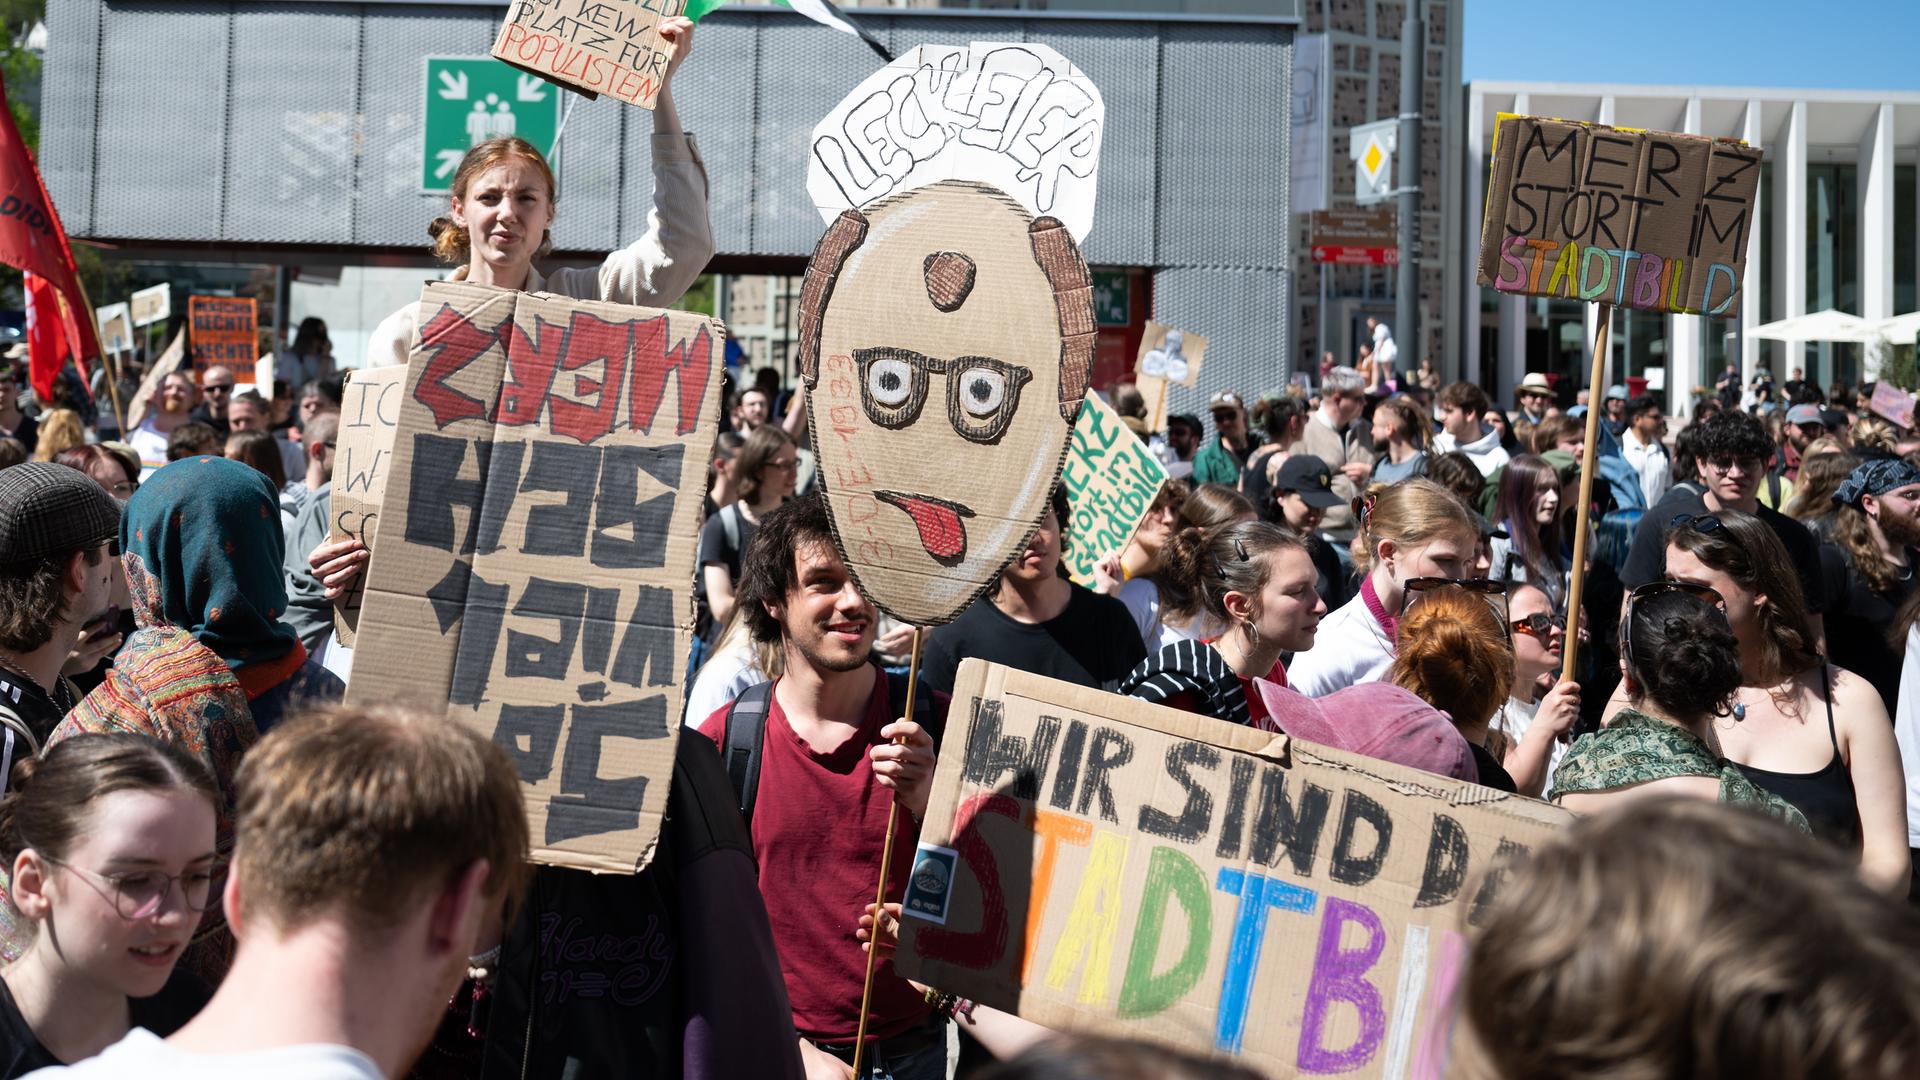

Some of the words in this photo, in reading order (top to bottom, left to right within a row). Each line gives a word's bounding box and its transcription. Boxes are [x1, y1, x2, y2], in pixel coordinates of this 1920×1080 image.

[500, 24, 661, 102] POPULISTEN
[618, 41, 667, 78] FÜR
[1517, 124, 1758, 203] MERZ
[1506, 183, 1664, 250] STÖRT
[1494, 236, 1737, 316] STADTBILD
[347, 382, 399, 427] IC
[414, 303, 713, 445] MERZ
[1063, 399, 1119, 501] ERZ
[1100, 451, 1130, 486] im
[961, 696, 1135, 826] WIR
[1138, 740, 1393, 887] SIND
